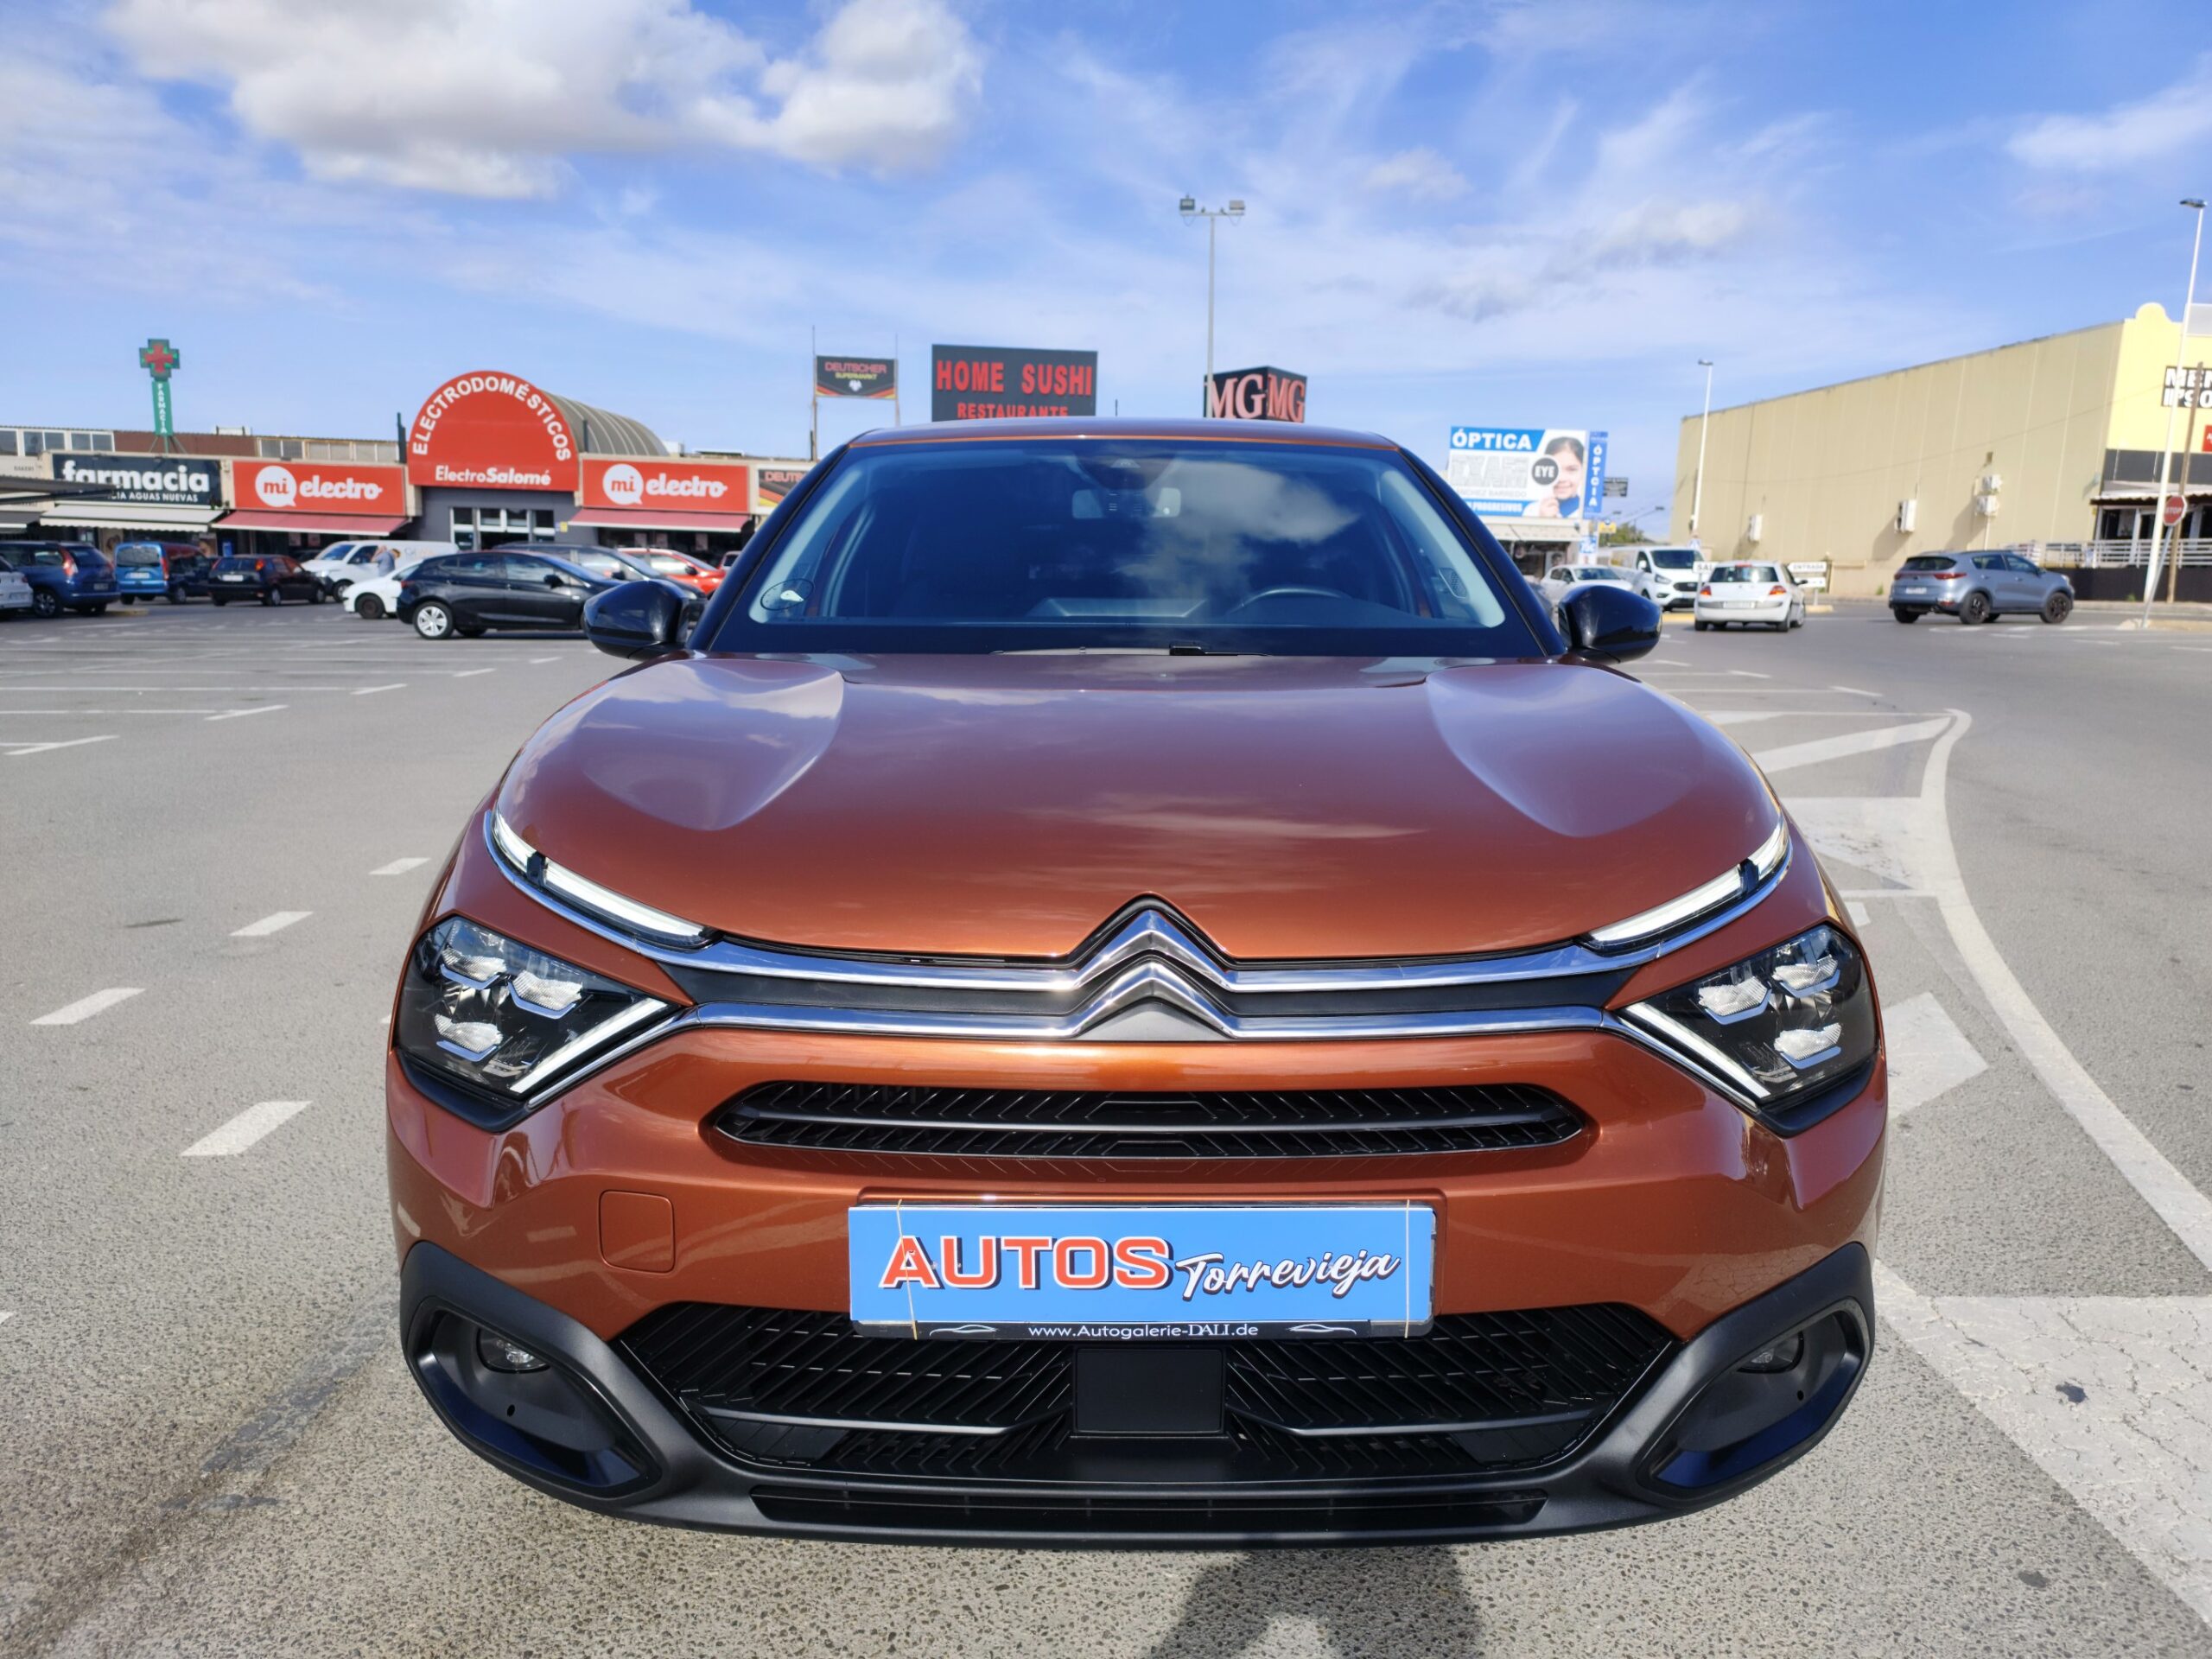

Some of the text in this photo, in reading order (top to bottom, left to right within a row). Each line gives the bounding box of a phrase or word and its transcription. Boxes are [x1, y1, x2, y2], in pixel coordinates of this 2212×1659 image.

[824, 362, 887, 373] DEUTSCHER
[936, 359, 1093, 397] HOME SUSHI
[157, 383, 168, 434] FARMACIA
[1204, 373, 1266, 419] MG
[1268, 373, 1306, 423] MG
[412, 375, 572, 461] ELECTRODOMÉSTICOS
[957, 402, 1069, 419] RESTAURANTE
[1452, 429, 1532, 450] ÓPTICA
[62, 461, 211, 493] farmacia
[435, 464, 552, 486] ElectroSalomé
[1535, 465, 1555, 478] EYE
[129, 492, 161, 501] AGUAS
[162, 493, 199, 503] NUEVAS
[264, 474, 384, 500] mi electro
[611, 473, 728, 499] mi electro
[878, 1236, 1402, 1301] AUTOS Torrevieja
[1027, 1323, 1259, 1339] www.Autogalerie-DALI.de
